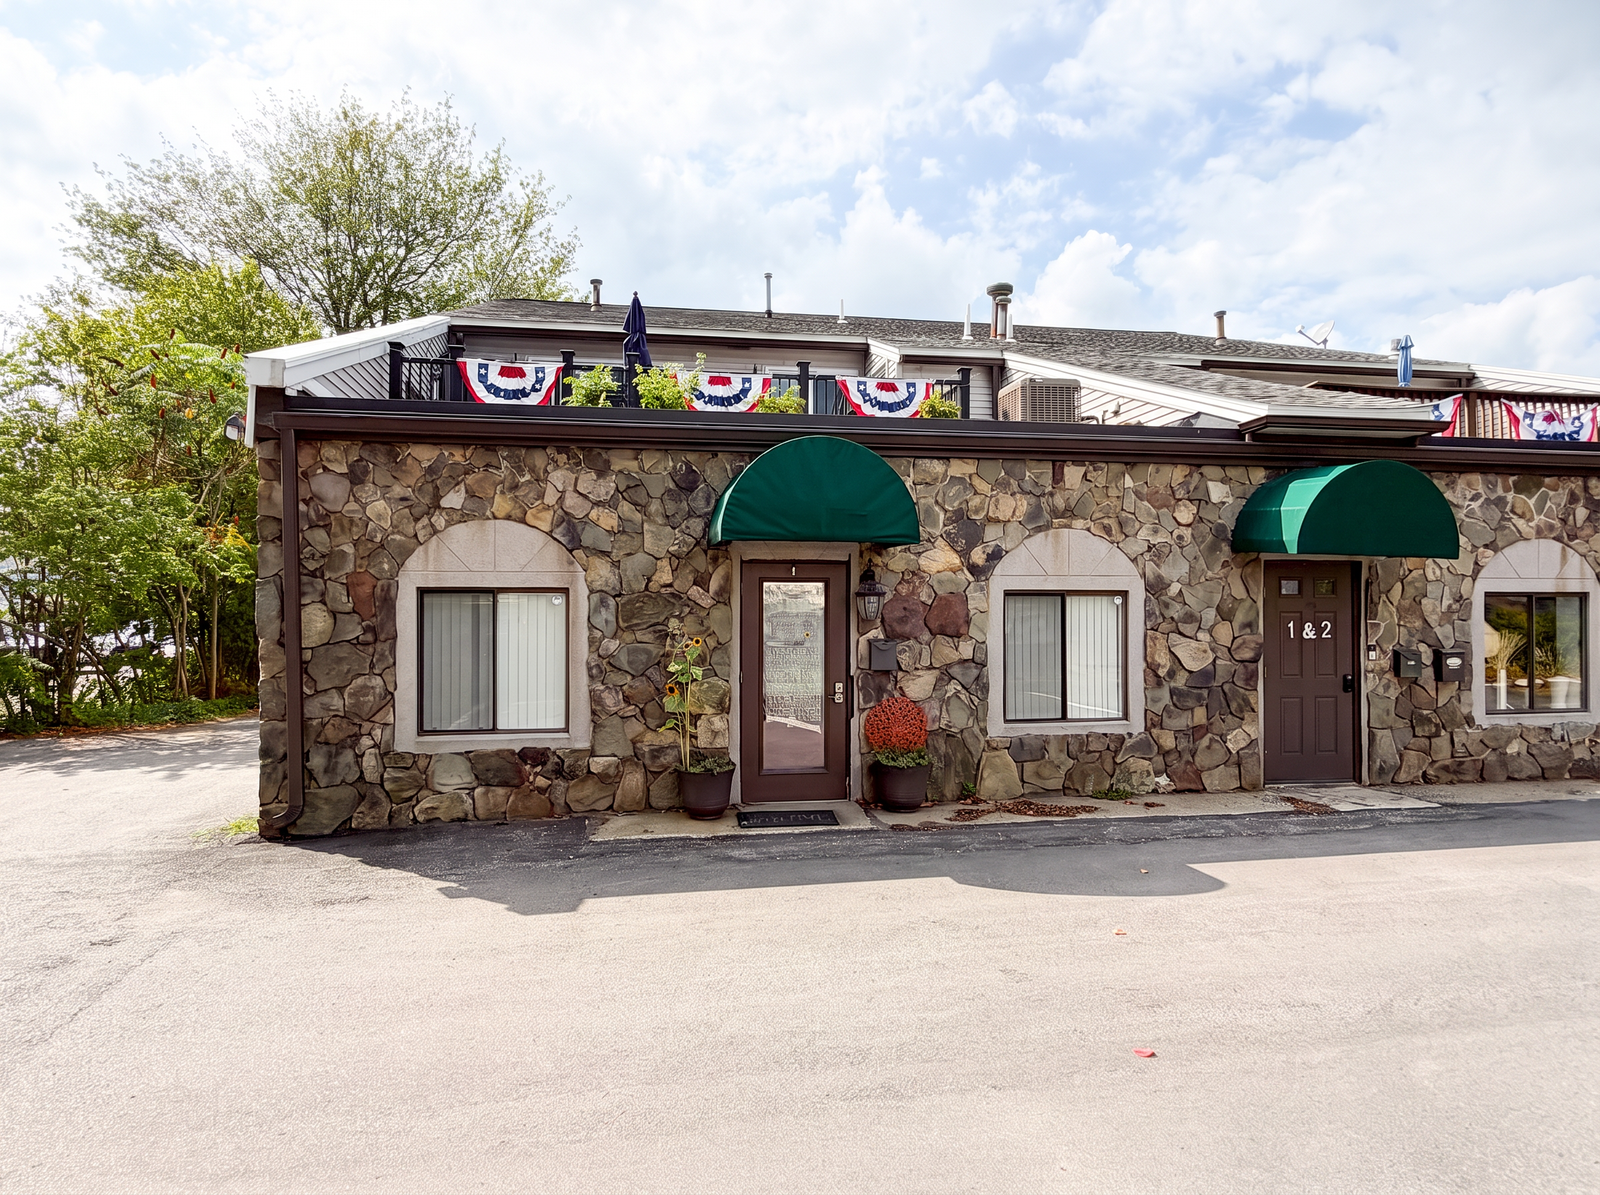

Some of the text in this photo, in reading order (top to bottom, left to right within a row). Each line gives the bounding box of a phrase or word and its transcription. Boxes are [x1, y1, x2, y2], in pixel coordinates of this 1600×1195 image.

[1287, 620, 1332, 639] 1 & 2
